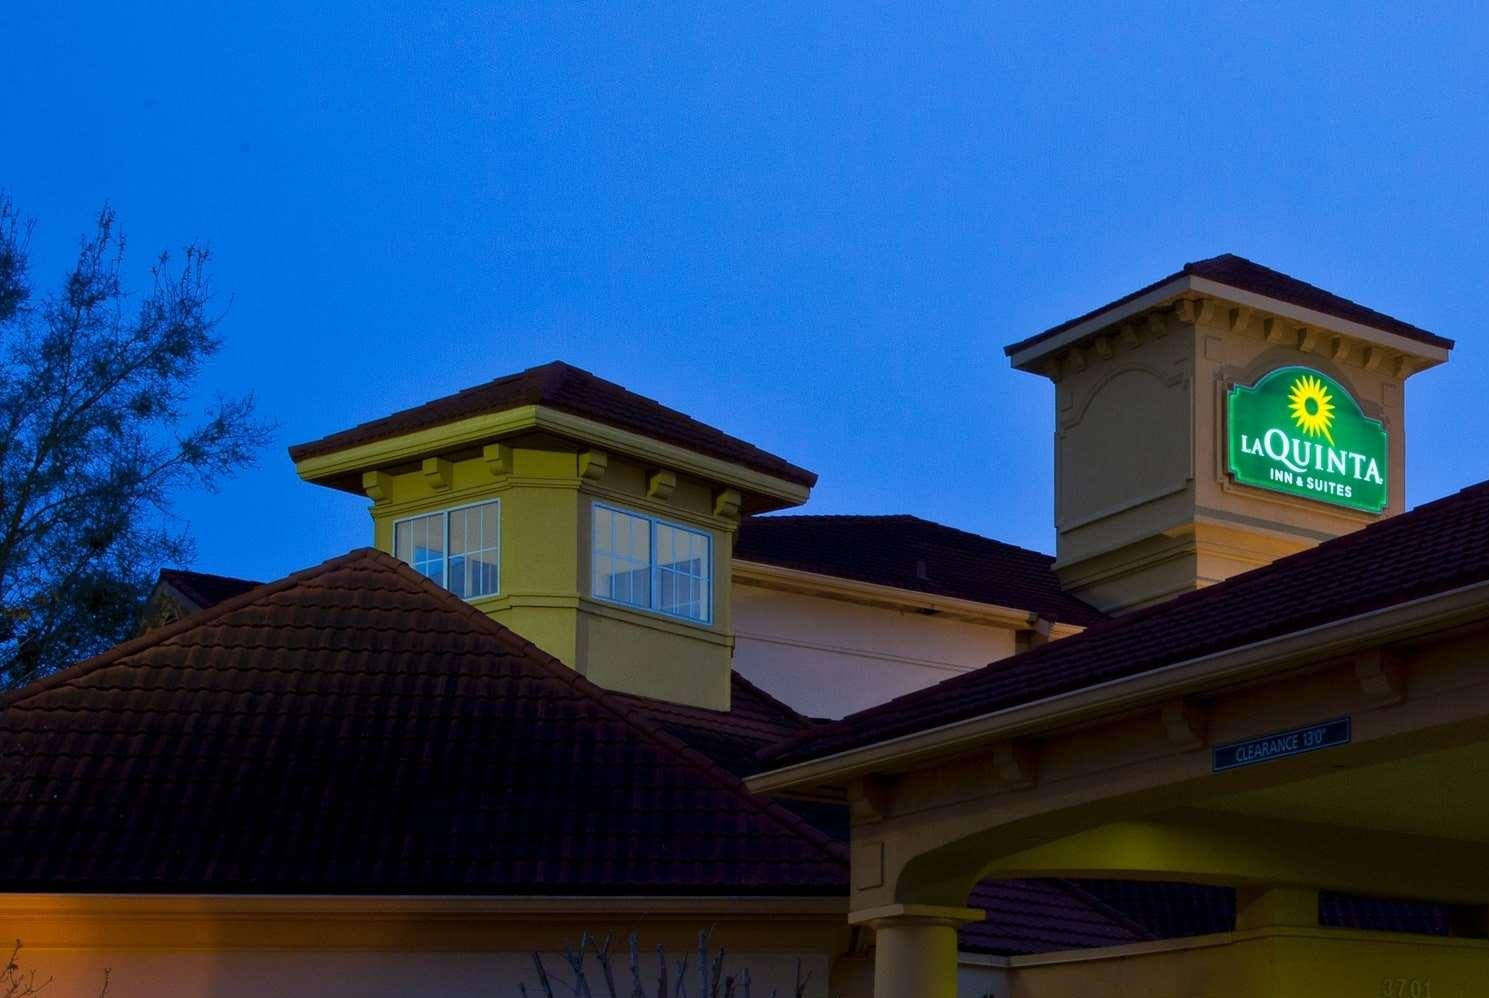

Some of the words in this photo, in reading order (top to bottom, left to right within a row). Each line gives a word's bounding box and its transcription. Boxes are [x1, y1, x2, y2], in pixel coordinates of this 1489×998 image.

[1264, 428, 1384, 485] QUINTA
[1270, 467, 1293, 485] INN
[1296, 477, 1304, 487] &
[1306, 477, 1353, 498] SUITES
[1235, 734, 1299, 762] CLEARANCE
